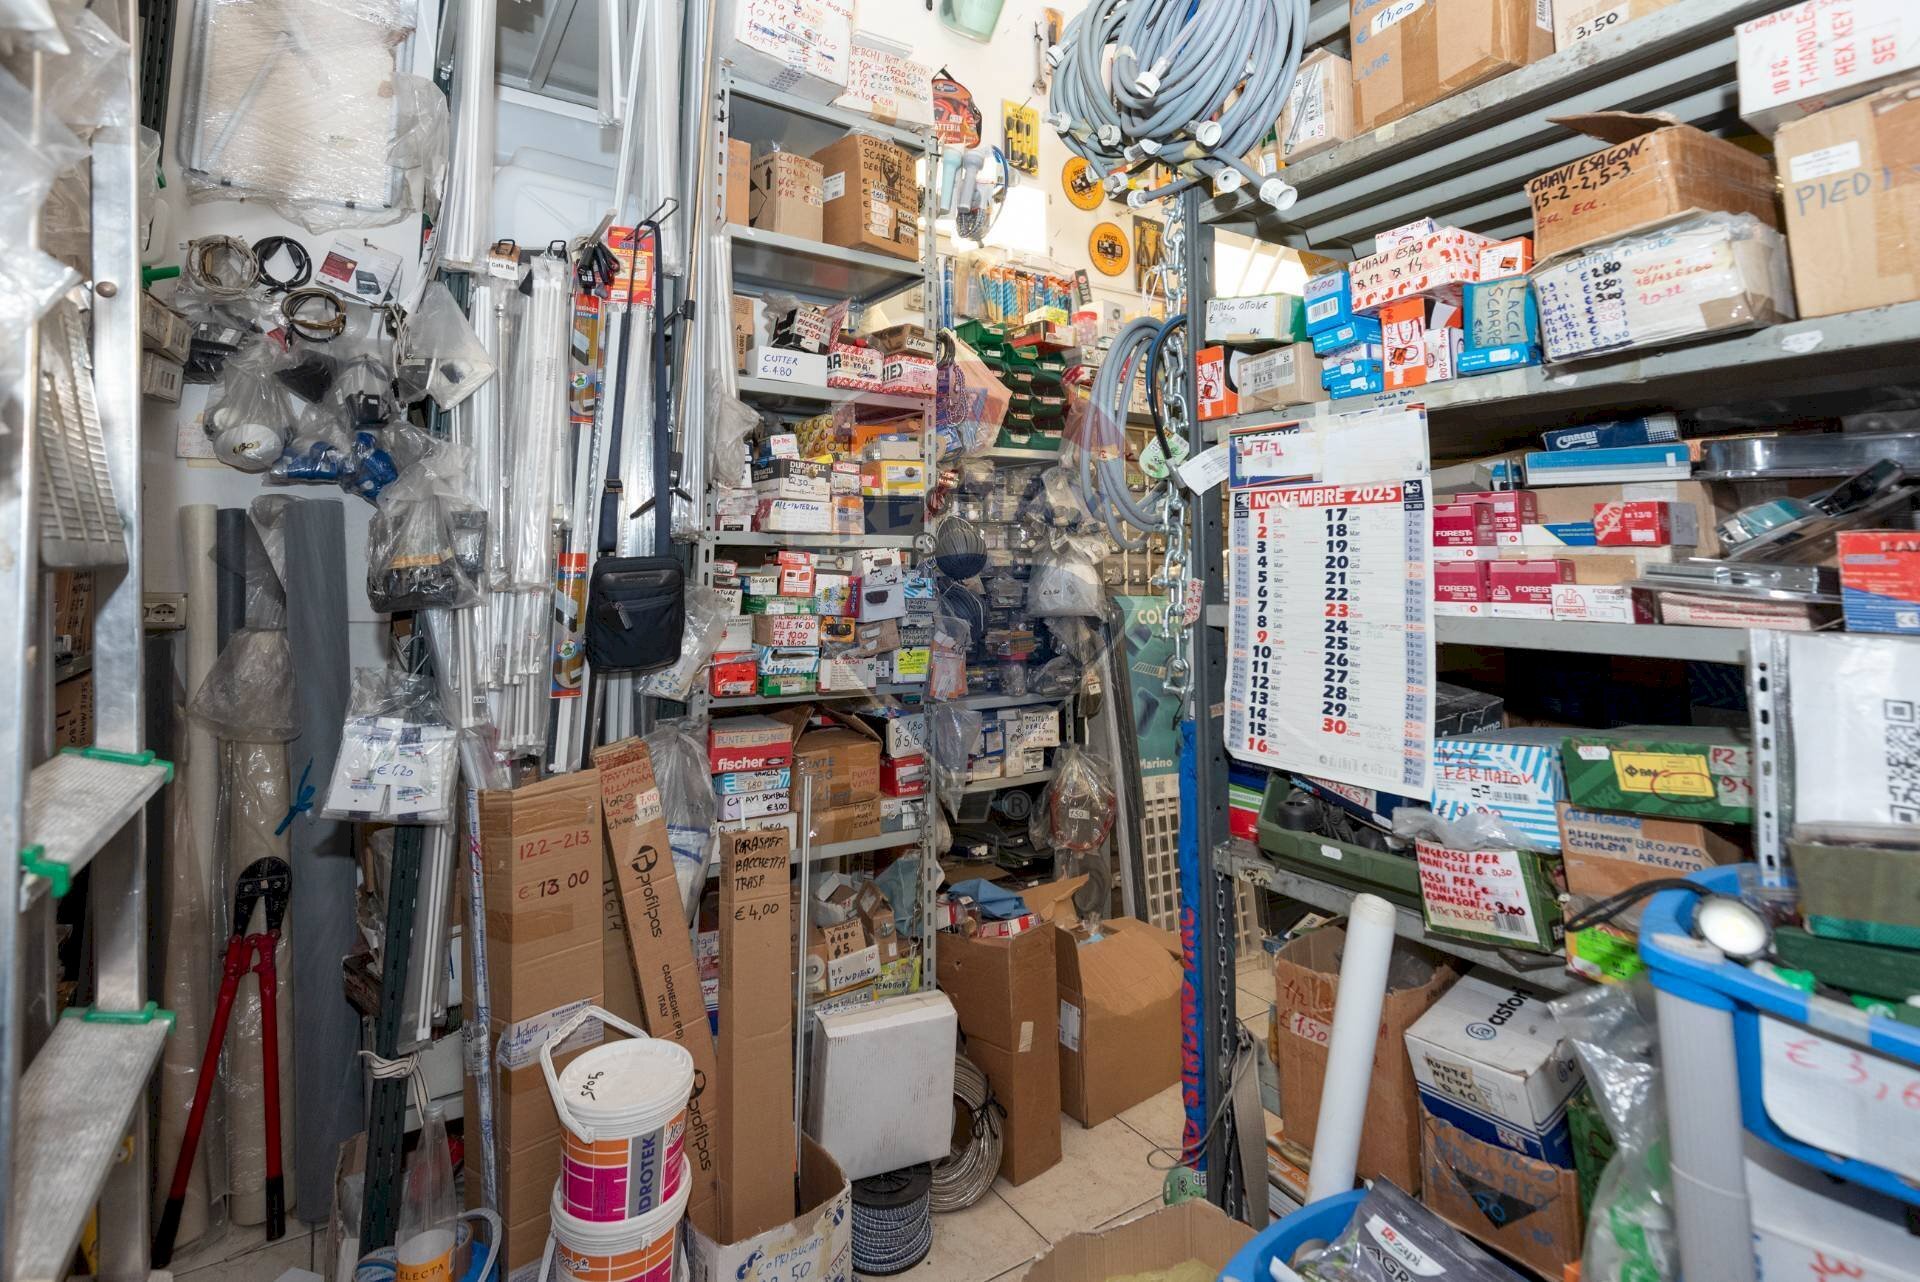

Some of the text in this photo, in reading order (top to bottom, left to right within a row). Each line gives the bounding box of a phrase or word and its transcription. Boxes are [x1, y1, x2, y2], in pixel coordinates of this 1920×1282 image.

[1576, 12, 1619, 40] 3,50
[1831, 10, 1857, 77] HEX KEY
[1871, 33, 1897, 65] SET
[1531, 165, 1577, 194] CHIAVI
[1487, 285, 1505, 347] SCARPE
[1506, 286, 1520, 340] LACCI
[764, 354, 799, 367] CUTTER
[790, 461, 827, 473] DURACELL
[1254, 486, 1396, 508] NOVEMBRE 2025
[1258, 511, 1265, 524] 1
[1325, 507, 1348, 522] 17
[1257, 526, 1268, 539] 2
[1326, 523, 1348, 538] 18
[1436, 529, 1470, 538] FOREST
[1256, 540, 1267, 554] 3
[1326, 539, 1348, 553] 19
[1257, 555, 1268, 569] 4
[1324, 555, 1349, 570] 20
[1257, 570, 1268, 584] 5
[1325, 571, 1346, 586] 21
[1257, 585, 1268, 599] 6
[1324, 587, 1349, 602] 22
[1438, 585, 1476, 593] FOREST
[1257, 599, 1268, 613] 7
[1325, 603, 1349, 618] 23
[1256, 614, 1268, 629] 8
[1324, 619, 1349, 634] 24
[1257, 630, 1268, 643] 9
[1324, 635, 1349, 651] 25
[1252, 644, 1272, 659] 10
[1324, 651, 1349, 667] 26
[1251, 659, 1269, 675] 11
[1251, 675, 1270, 690] 12
[1323, 667, 1349, 684] 27
[1250, 690, 1269, 706] 13
[1322, 684, 1348, 701] 28
[1248, 705, 1268, 721] 14
[1321, 700, 1347, 718] 29
[1248, 721, 1267, 737] 15
[1322, 717, 1347, 735] 30
[1247, 736, 1268, 753] 16
[377, 764, 388, 775] €
[718, 757, 766, 771] fischer
[735, 856, 787, 874] BACCHETTA
[1474, 853, 1500, 864] PER
[1421, 870, 1477, 888] ASSI PER
[639, 869, 663, 939] profilpas
[735, 909, 747, 922] €
[662, 963, 681, 1018] CADONEGHE
[658, 993, 669, 1018] ITALY
[1488, 986, 1534, 1026] astori
[688, 1101, 713, 1172] profilpas
[1394, 1242, 1423, 1267] zapi
